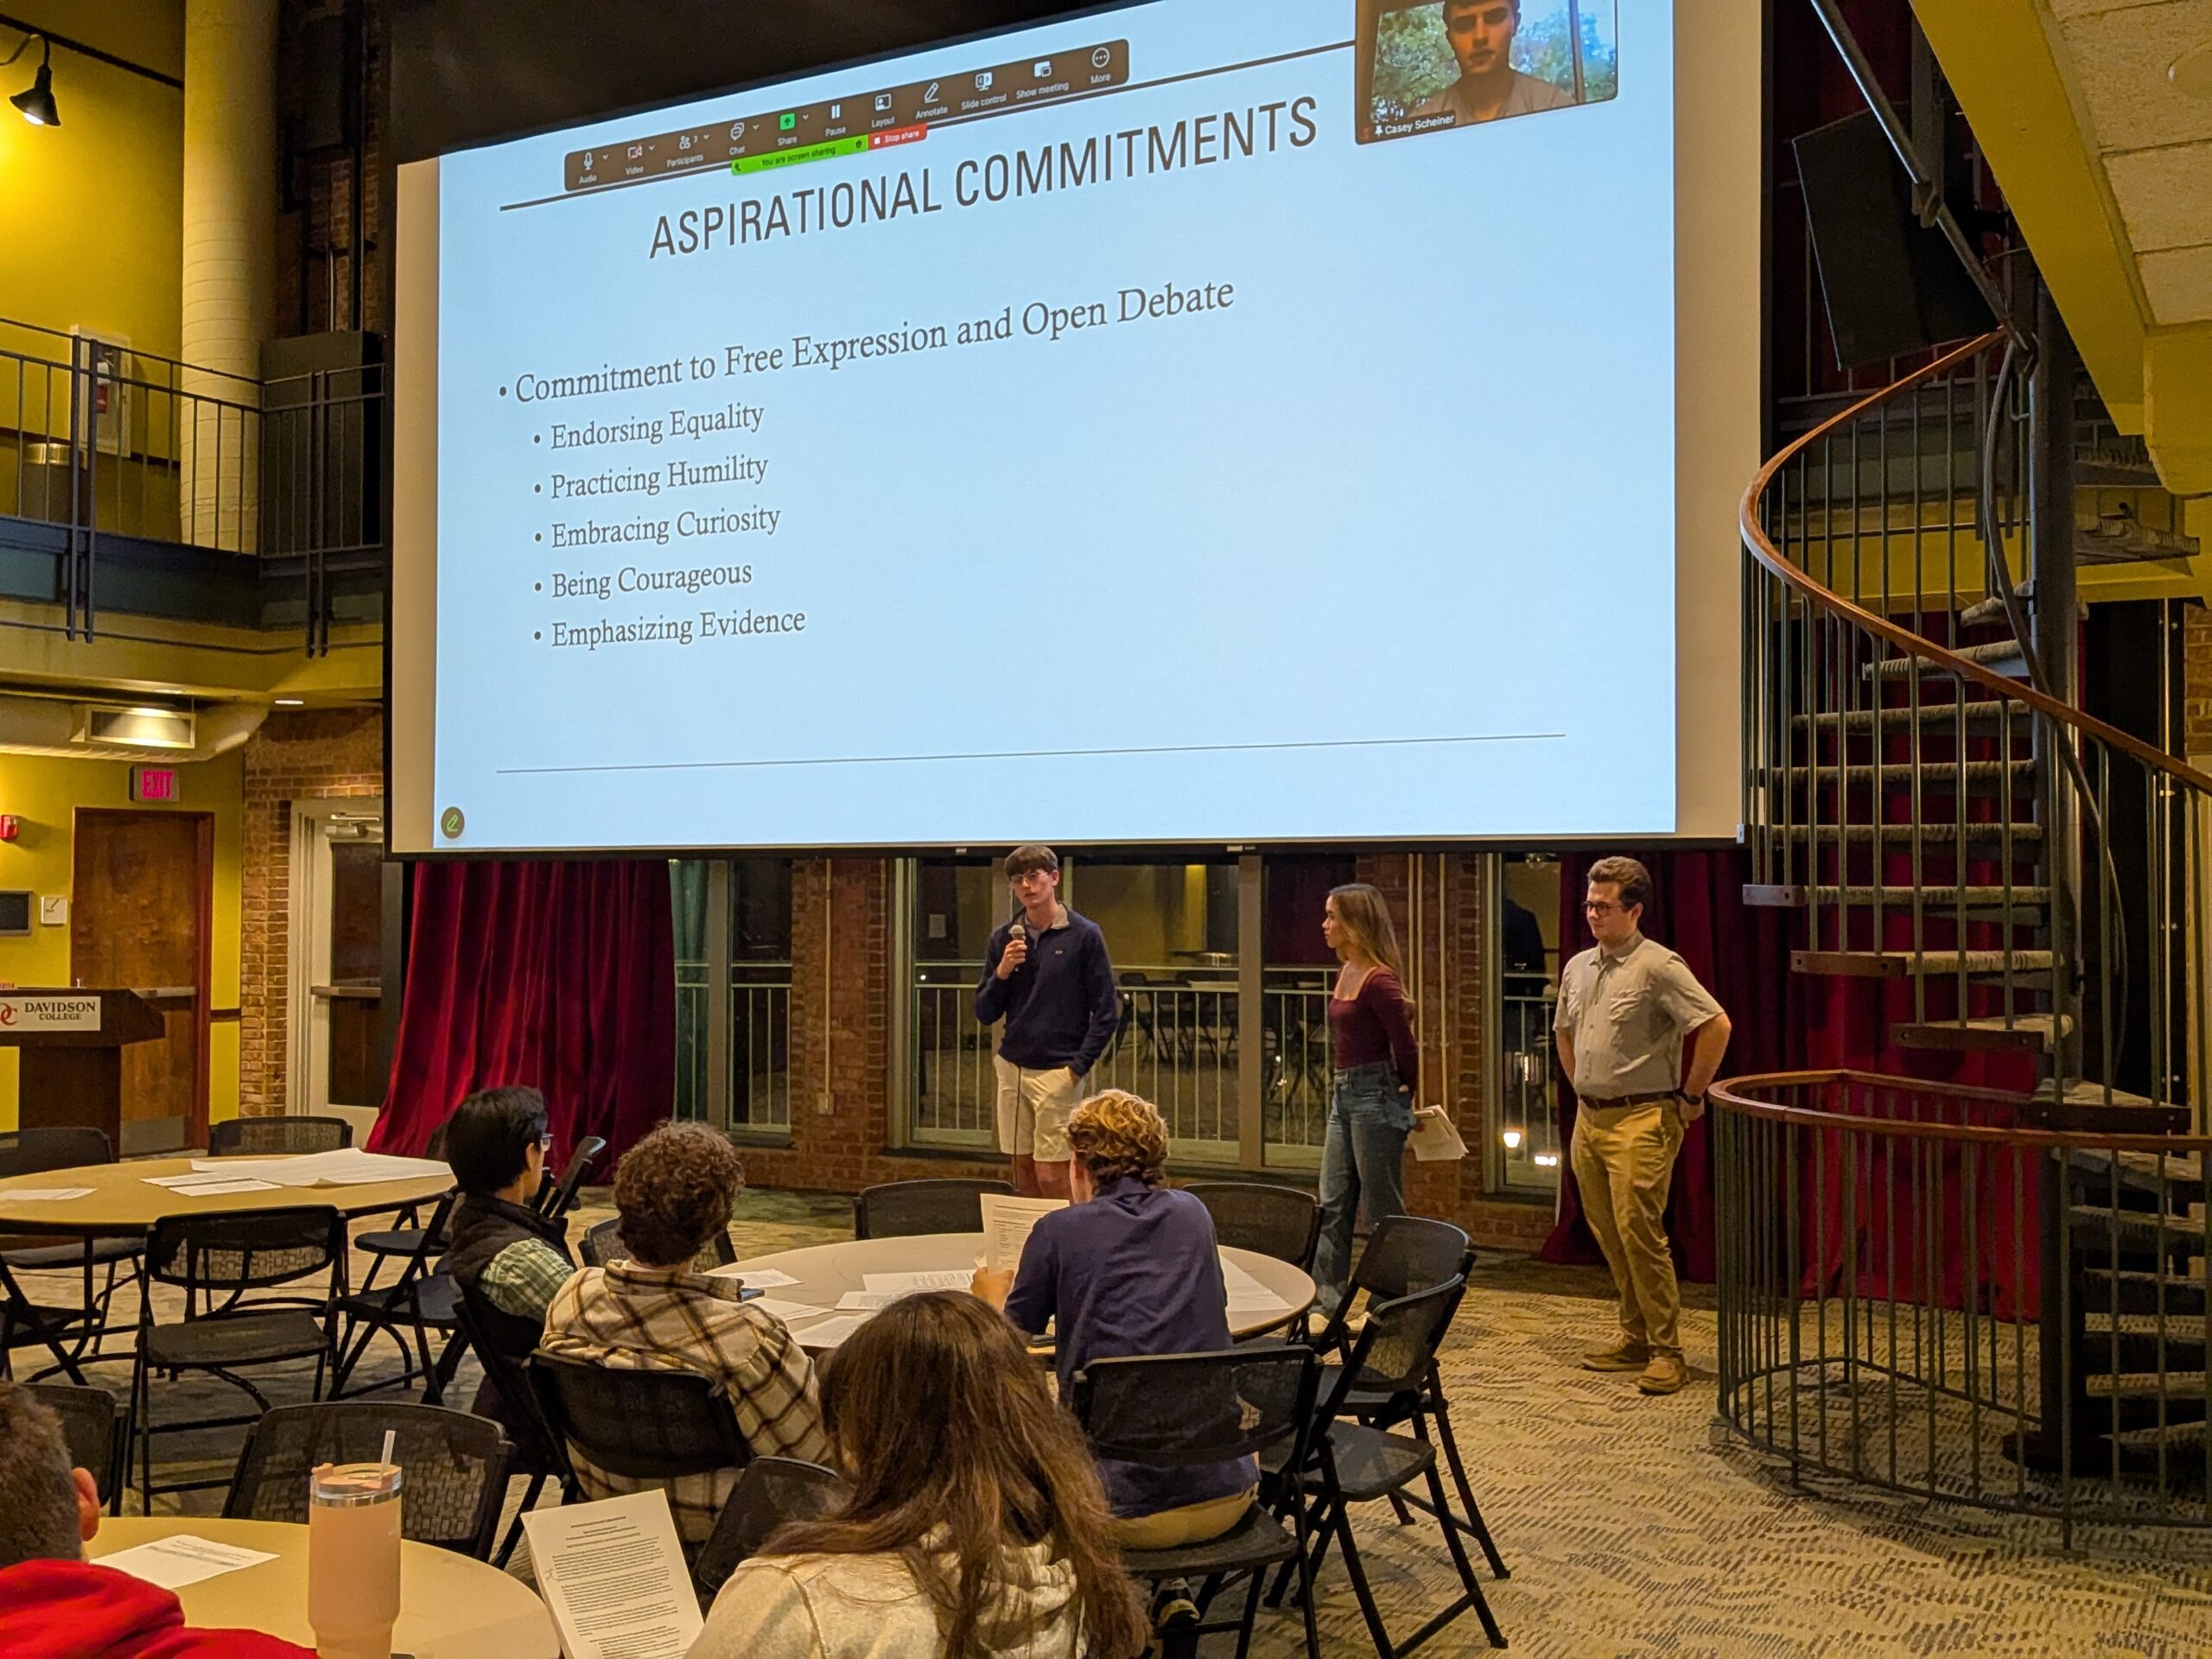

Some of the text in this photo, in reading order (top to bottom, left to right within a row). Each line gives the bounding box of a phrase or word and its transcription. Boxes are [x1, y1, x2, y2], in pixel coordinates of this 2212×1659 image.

[1090, 73, 1111, 84] More
[1016, 82, 1069, 99] Show meeting
[961, 93, 1007, 110] Slide control
[916, 106, 948, 119] Annotate
[871, 116, 895, 129] Layout
[1384, 115, 1454, 135] Casey Scheiner
[825, 126, 847, 137] Pause
[884, 130, 920, 143] Stop share
[778, 136, 798, 146] Share
[729, 145, 746, 156] Chat
[761, 158, 774, 167] You
[787, 152, 810, 162] screen
[810, 146, 836, 159] sharing
[666, 154, 704, 168] Participants
[626, 166, 644, 175] Video
[650, 97, 1316, 258] ASPIRATIONAL COMMITMENTS
[579, 175, 597, 184] Audio
[516, 282, 1234, 403] Commitment to Free Expression and Open Debate
[550, 402, 765, 450] Endorsing Equality
[550, 454, 769, 499] Practicing Humility
[551, 504, 781, 549] Embracing Curiosity
[552, 564, 752, 601] Being Courageous
[551, 608, 805, 652] Emphasizing Evidence
[142, 769, 174, 799] EXIT
[24, 1001, 96, 1013] DAVIDSON
